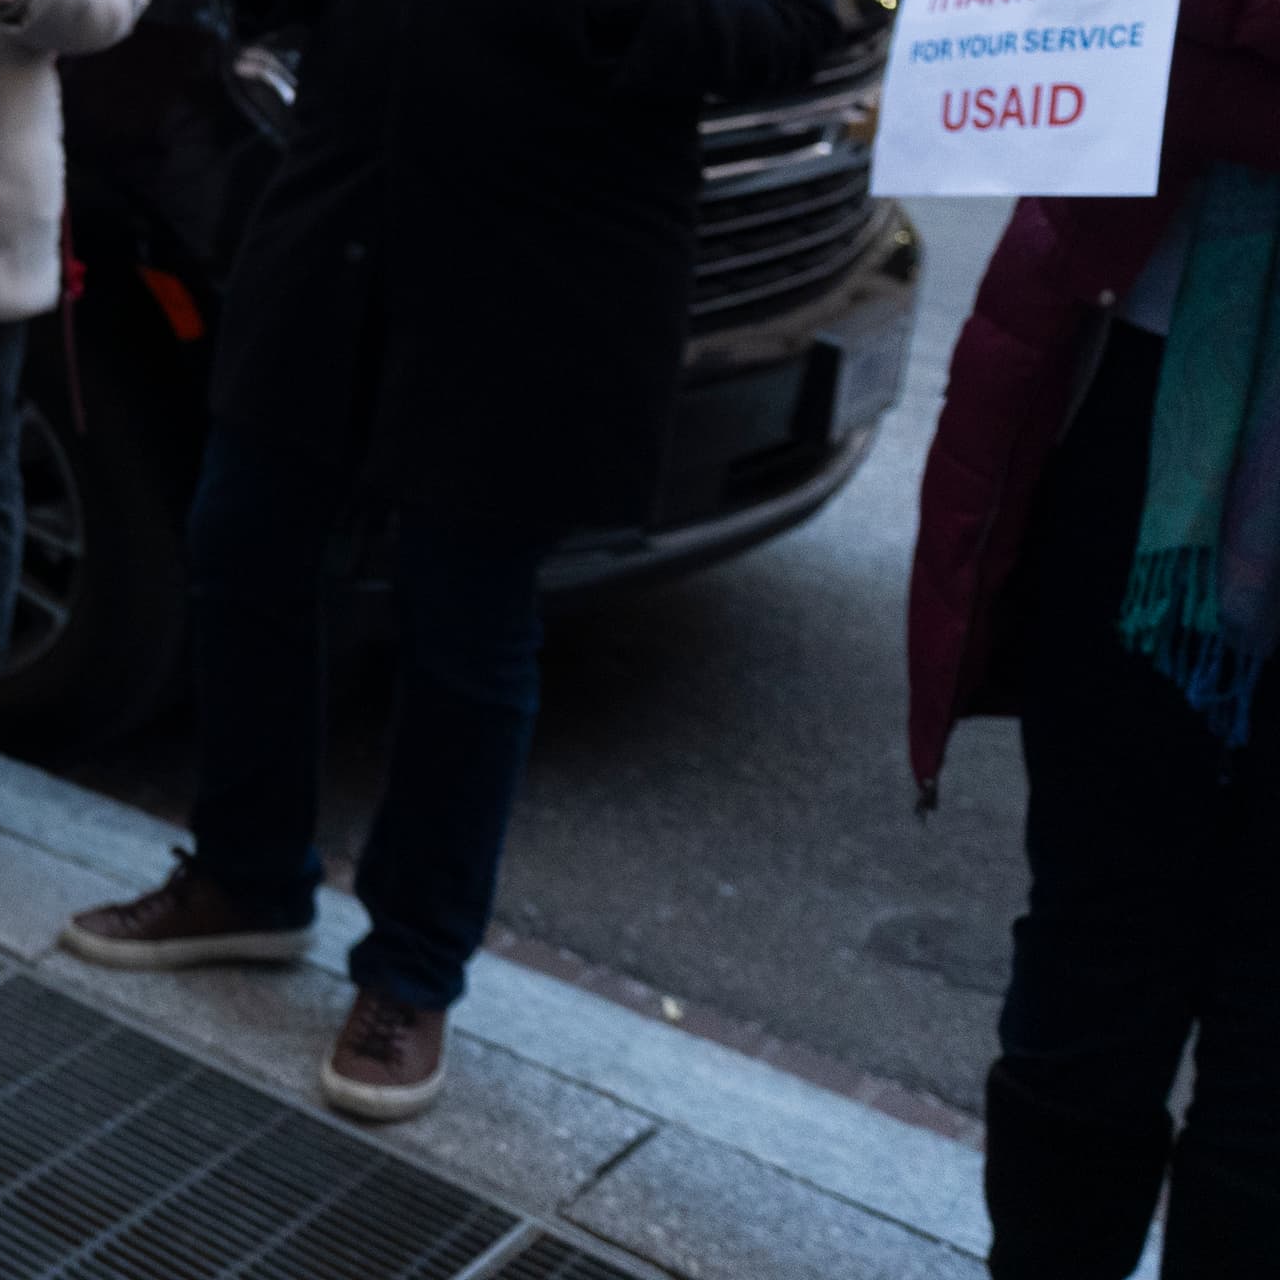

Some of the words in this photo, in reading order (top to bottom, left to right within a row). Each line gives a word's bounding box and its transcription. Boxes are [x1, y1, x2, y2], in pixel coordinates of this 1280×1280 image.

[910, 38, 952, 64] FOR
[957, 36, 1017, 60] YOUR
[1023, 22, 1145, 53] SERVICE
[941, 82, 1086, 133] USAID
